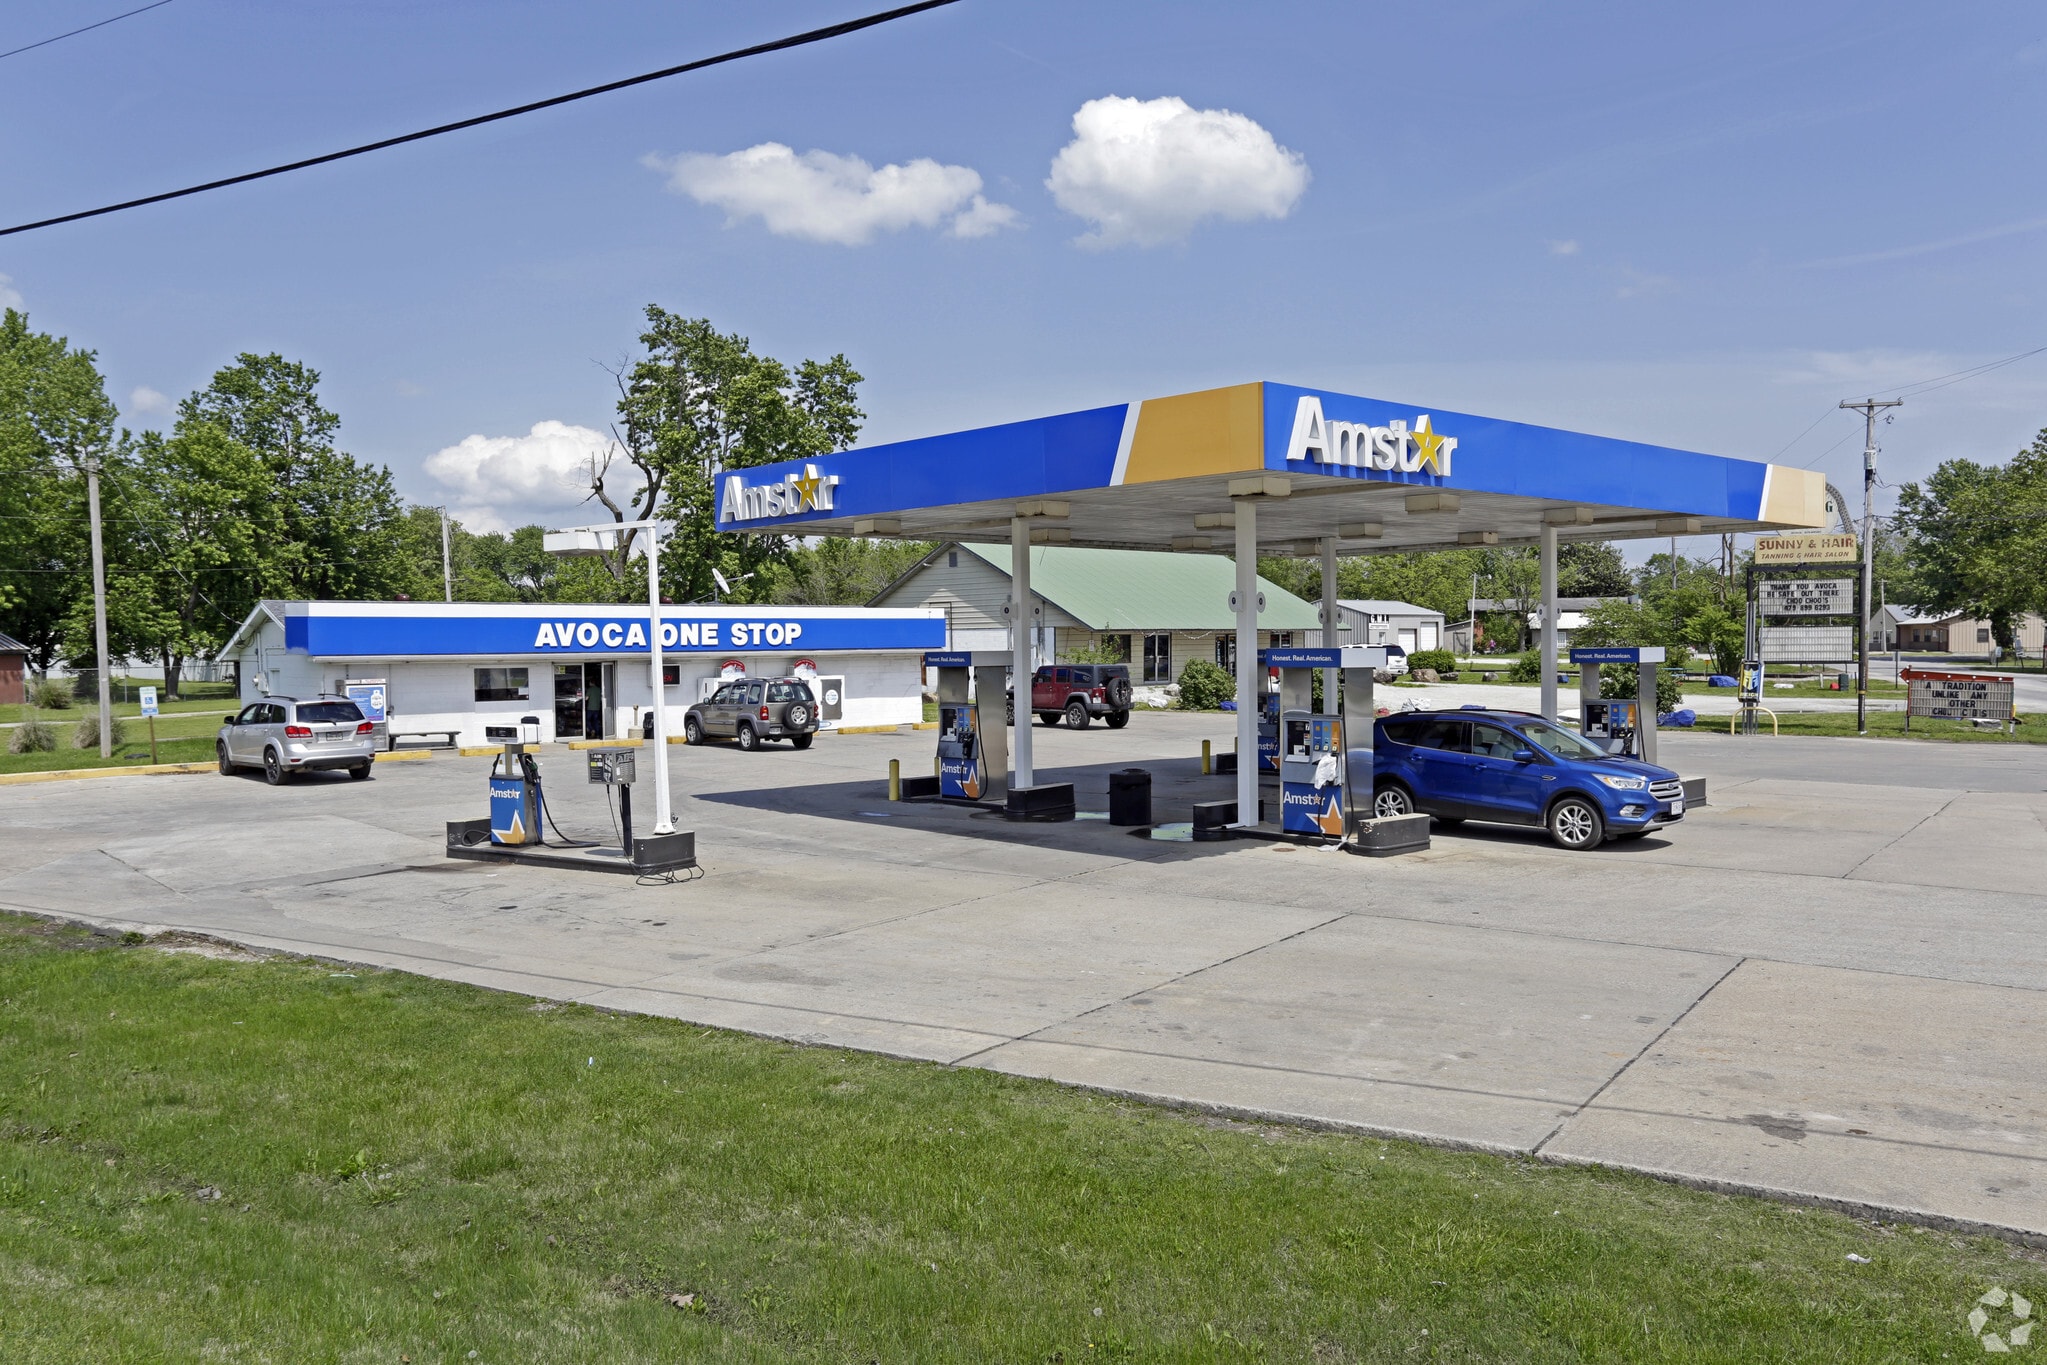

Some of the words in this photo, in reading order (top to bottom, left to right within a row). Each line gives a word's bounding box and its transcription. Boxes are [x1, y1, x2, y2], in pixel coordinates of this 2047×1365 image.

[1758, 540, 1803, 551] SUNNY
[1808, 539, 1817, 549] &
[1822, 538, 1854, 548] HAIR
[1761, 552, 1794, 560] TANNING
[534, 622, 647, 647] AVOCA
[660, 622, 719, 647] ONE
[731, 622, 803, 647] STOP
[1306, 654, 1333, 662] American.
[1942, 681, 1987, 691] TRADITION
[1932, 691, 1960, 699] UNLIKE
[1970, 692, 1988, 700] ANY
[1949, 699, 1976, 708] OTHER
